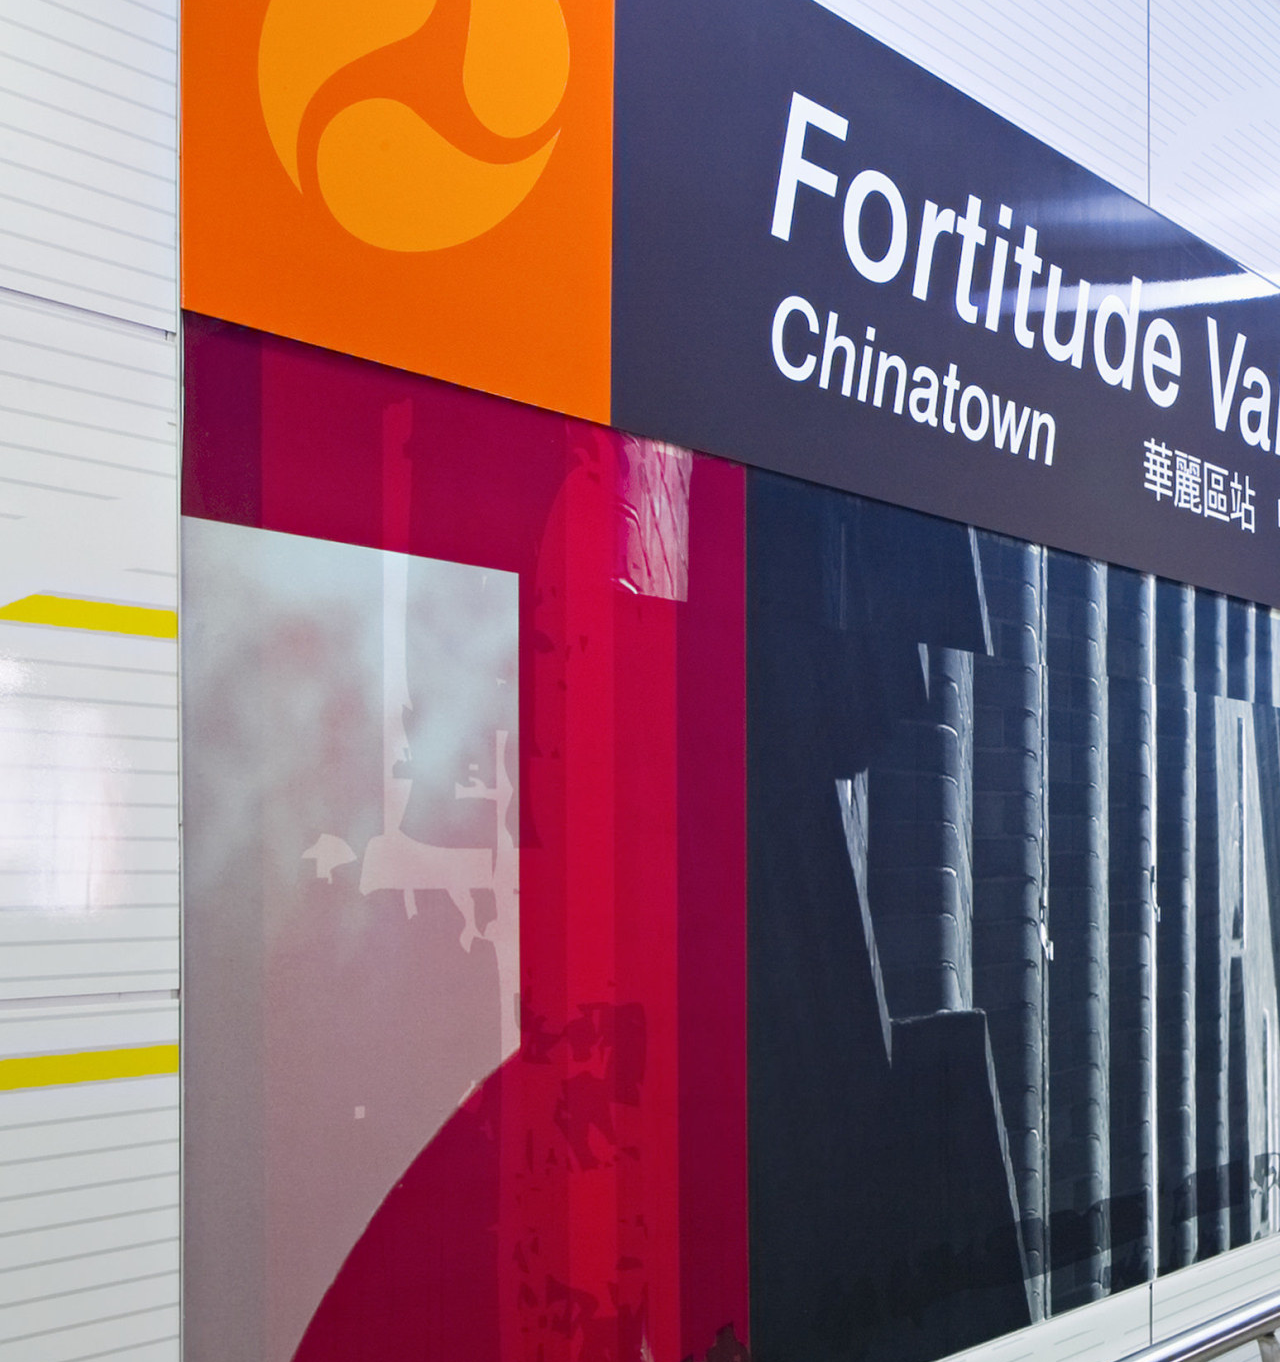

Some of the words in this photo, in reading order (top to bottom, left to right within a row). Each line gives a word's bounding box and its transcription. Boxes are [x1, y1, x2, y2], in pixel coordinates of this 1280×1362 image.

[770, 91, 1182, 408] Fortitude
[771, 295, 1057, 467] Chinatown
[1143, 437, 1256, 534] 華麗區站
